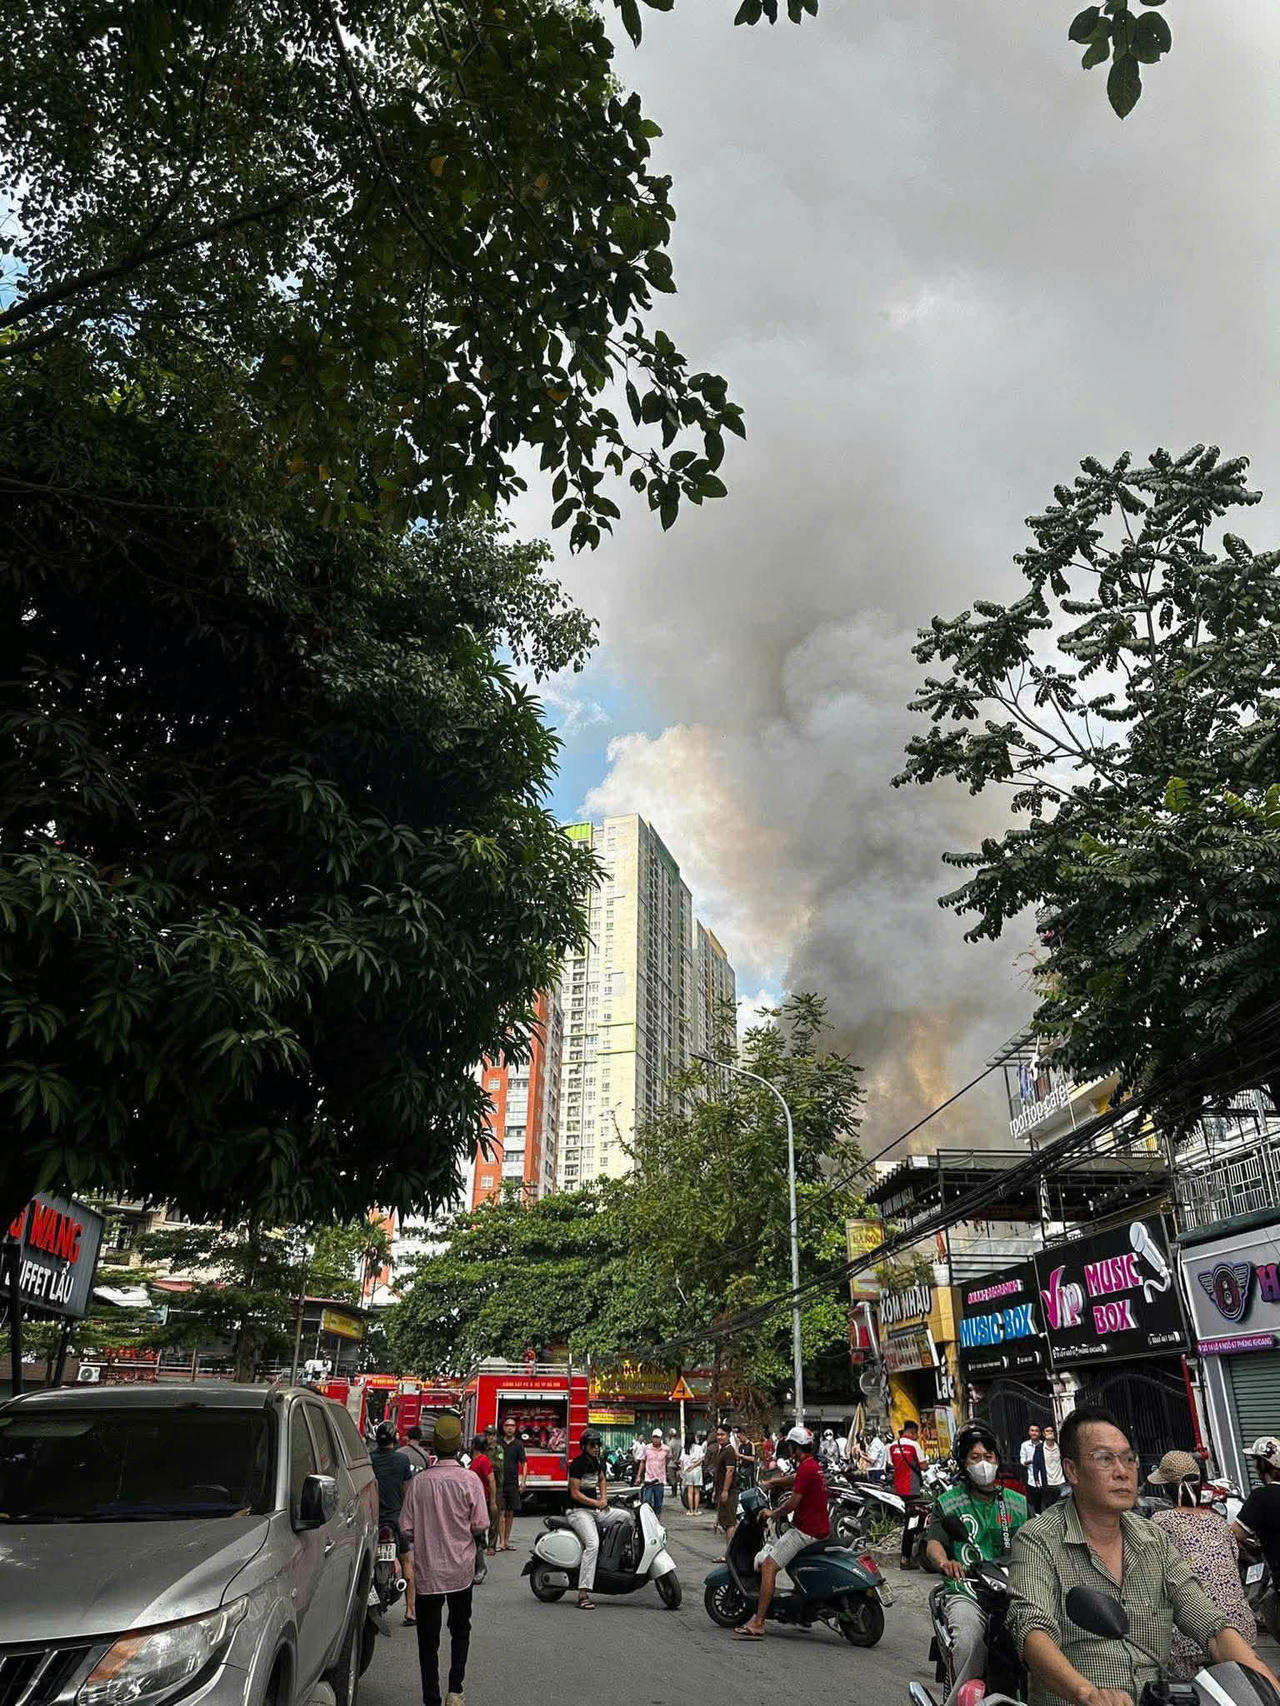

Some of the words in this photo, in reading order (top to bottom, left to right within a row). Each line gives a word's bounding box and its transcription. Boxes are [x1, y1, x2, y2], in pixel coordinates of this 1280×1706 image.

[29, 1199, 83, 1264] WANG
[1084, 1252, 1144, 1297] MUSIC
[880, 1289, 902, 1323] XÓM
[902, 1286, 931, 1321] NHẬU
[960, 1313, 1003, 1348] MUSIC
[1002, 1302, 1036, 1340] BOX
[1093, 1298, 1137, 1335] BOX
